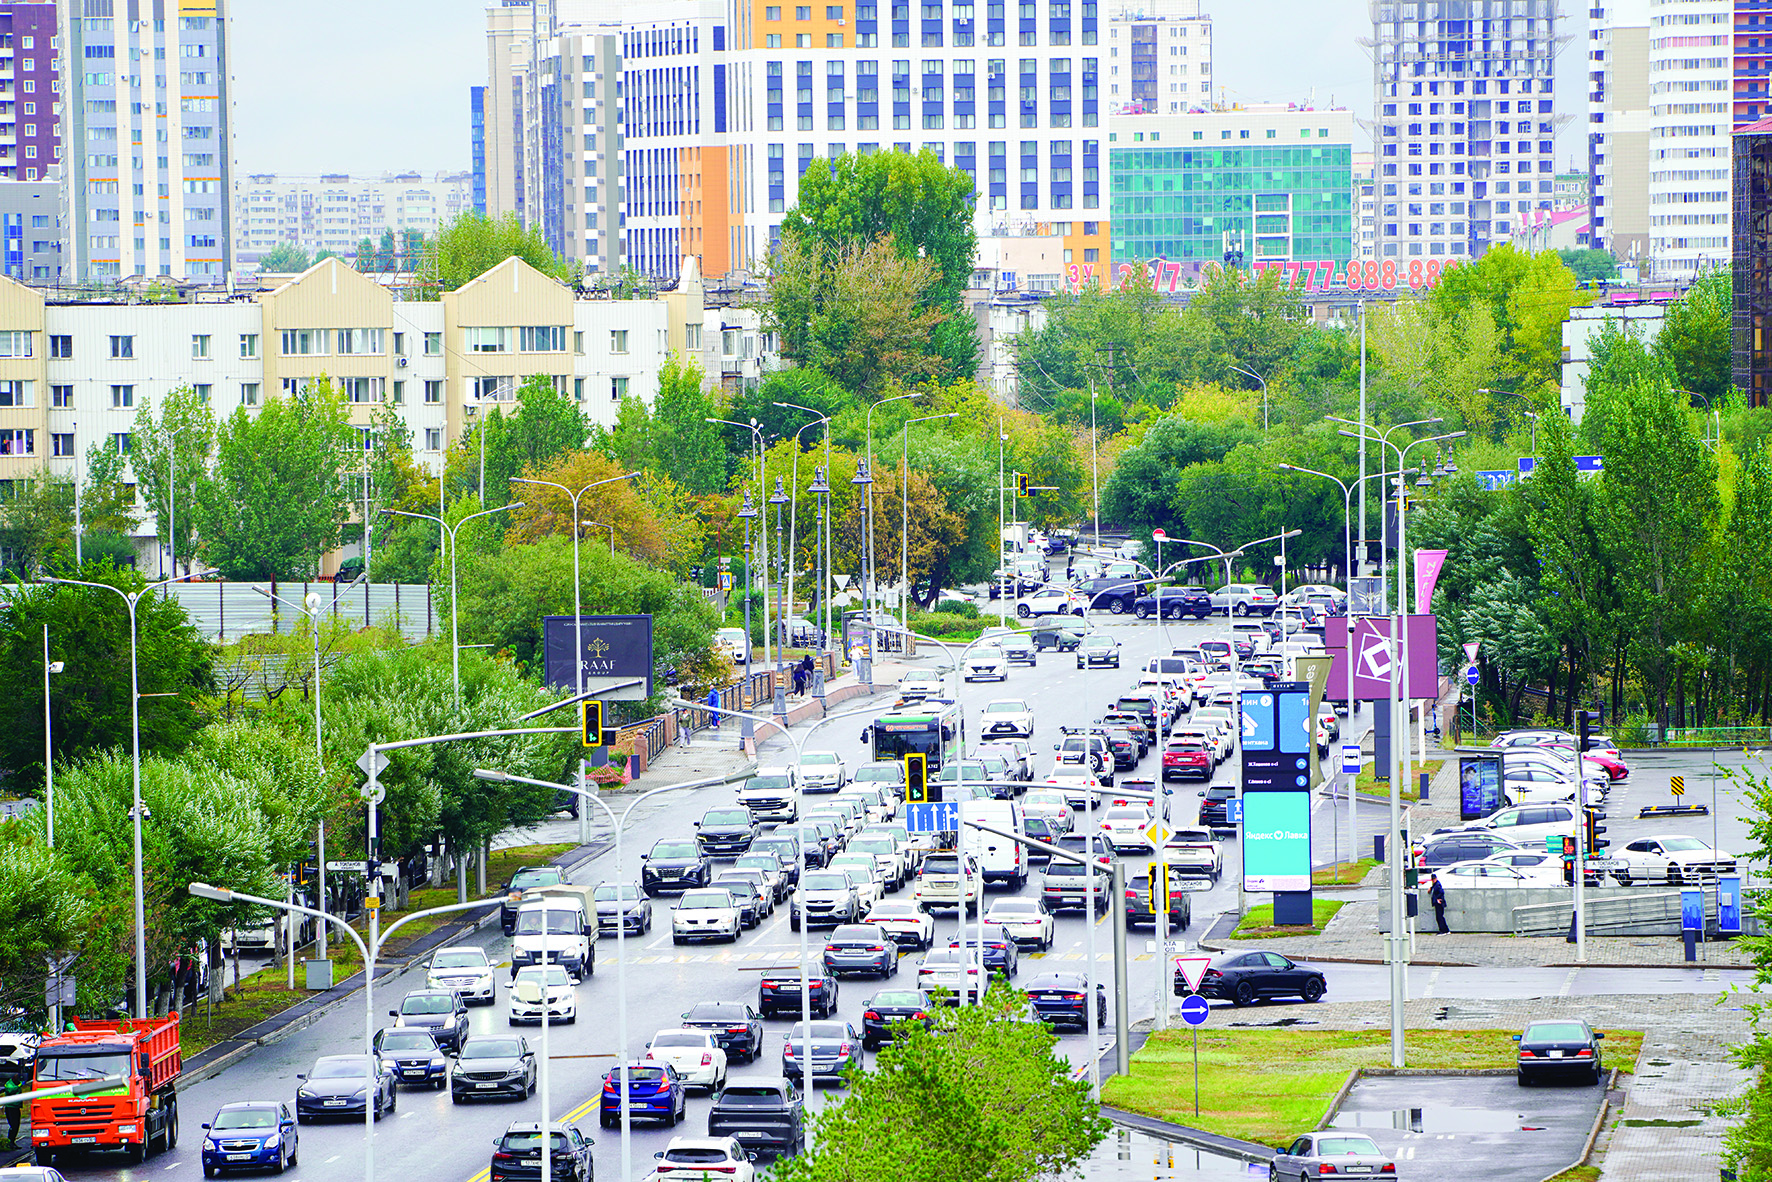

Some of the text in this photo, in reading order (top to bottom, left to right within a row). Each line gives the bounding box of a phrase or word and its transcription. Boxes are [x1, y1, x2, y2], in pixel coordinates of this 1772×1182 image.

[580, 660, 616, 670] RAAF
[1245, 831, 1308, 840] Яндекс Лавка
